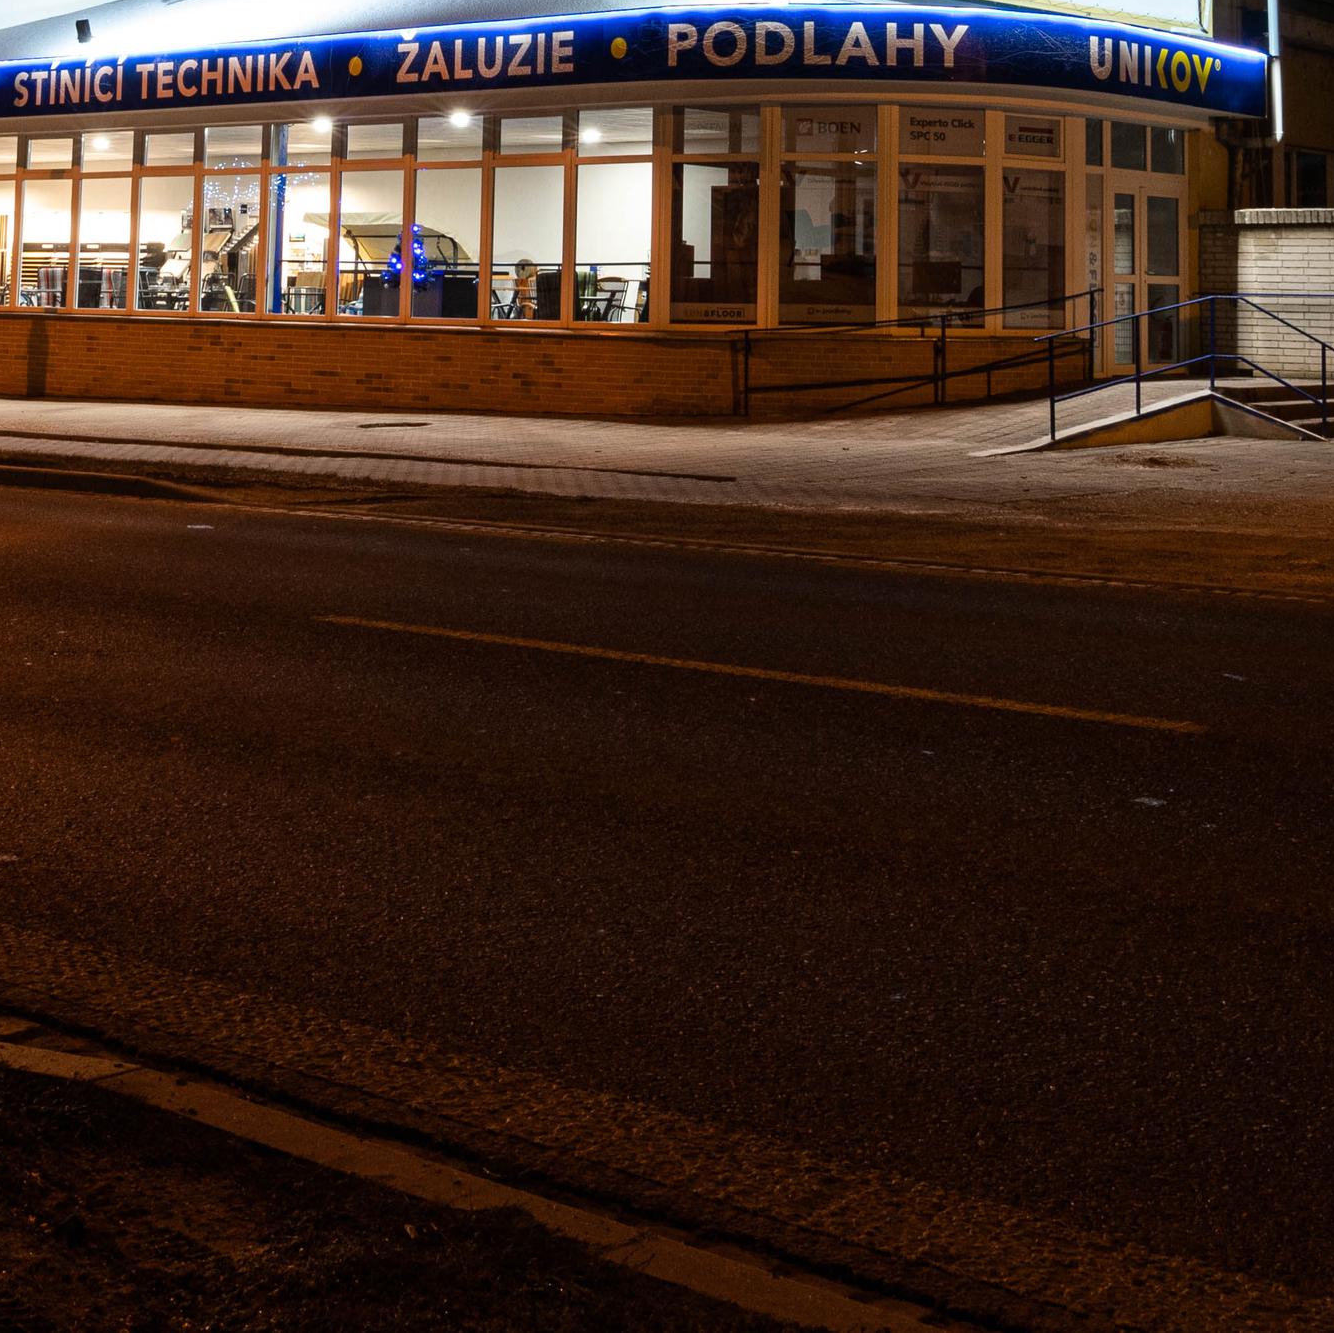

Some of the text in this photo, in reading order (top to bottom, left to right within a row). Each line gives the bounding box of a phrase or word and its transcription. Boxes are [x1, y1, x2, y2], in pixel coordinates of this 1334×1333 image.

[14, 57, 124, 107] STÍNÍCÍ
[136, 50, 320, 99] TECHNIKA
[396, 28, 574, 82] ŽALUZIE
[667, 22, 969, 68] PODLAHY
[817, 121, 861, 134] BOEN
[909, 116, 975, 129] Experto Click
[909, 130, 931, 141] SPC
